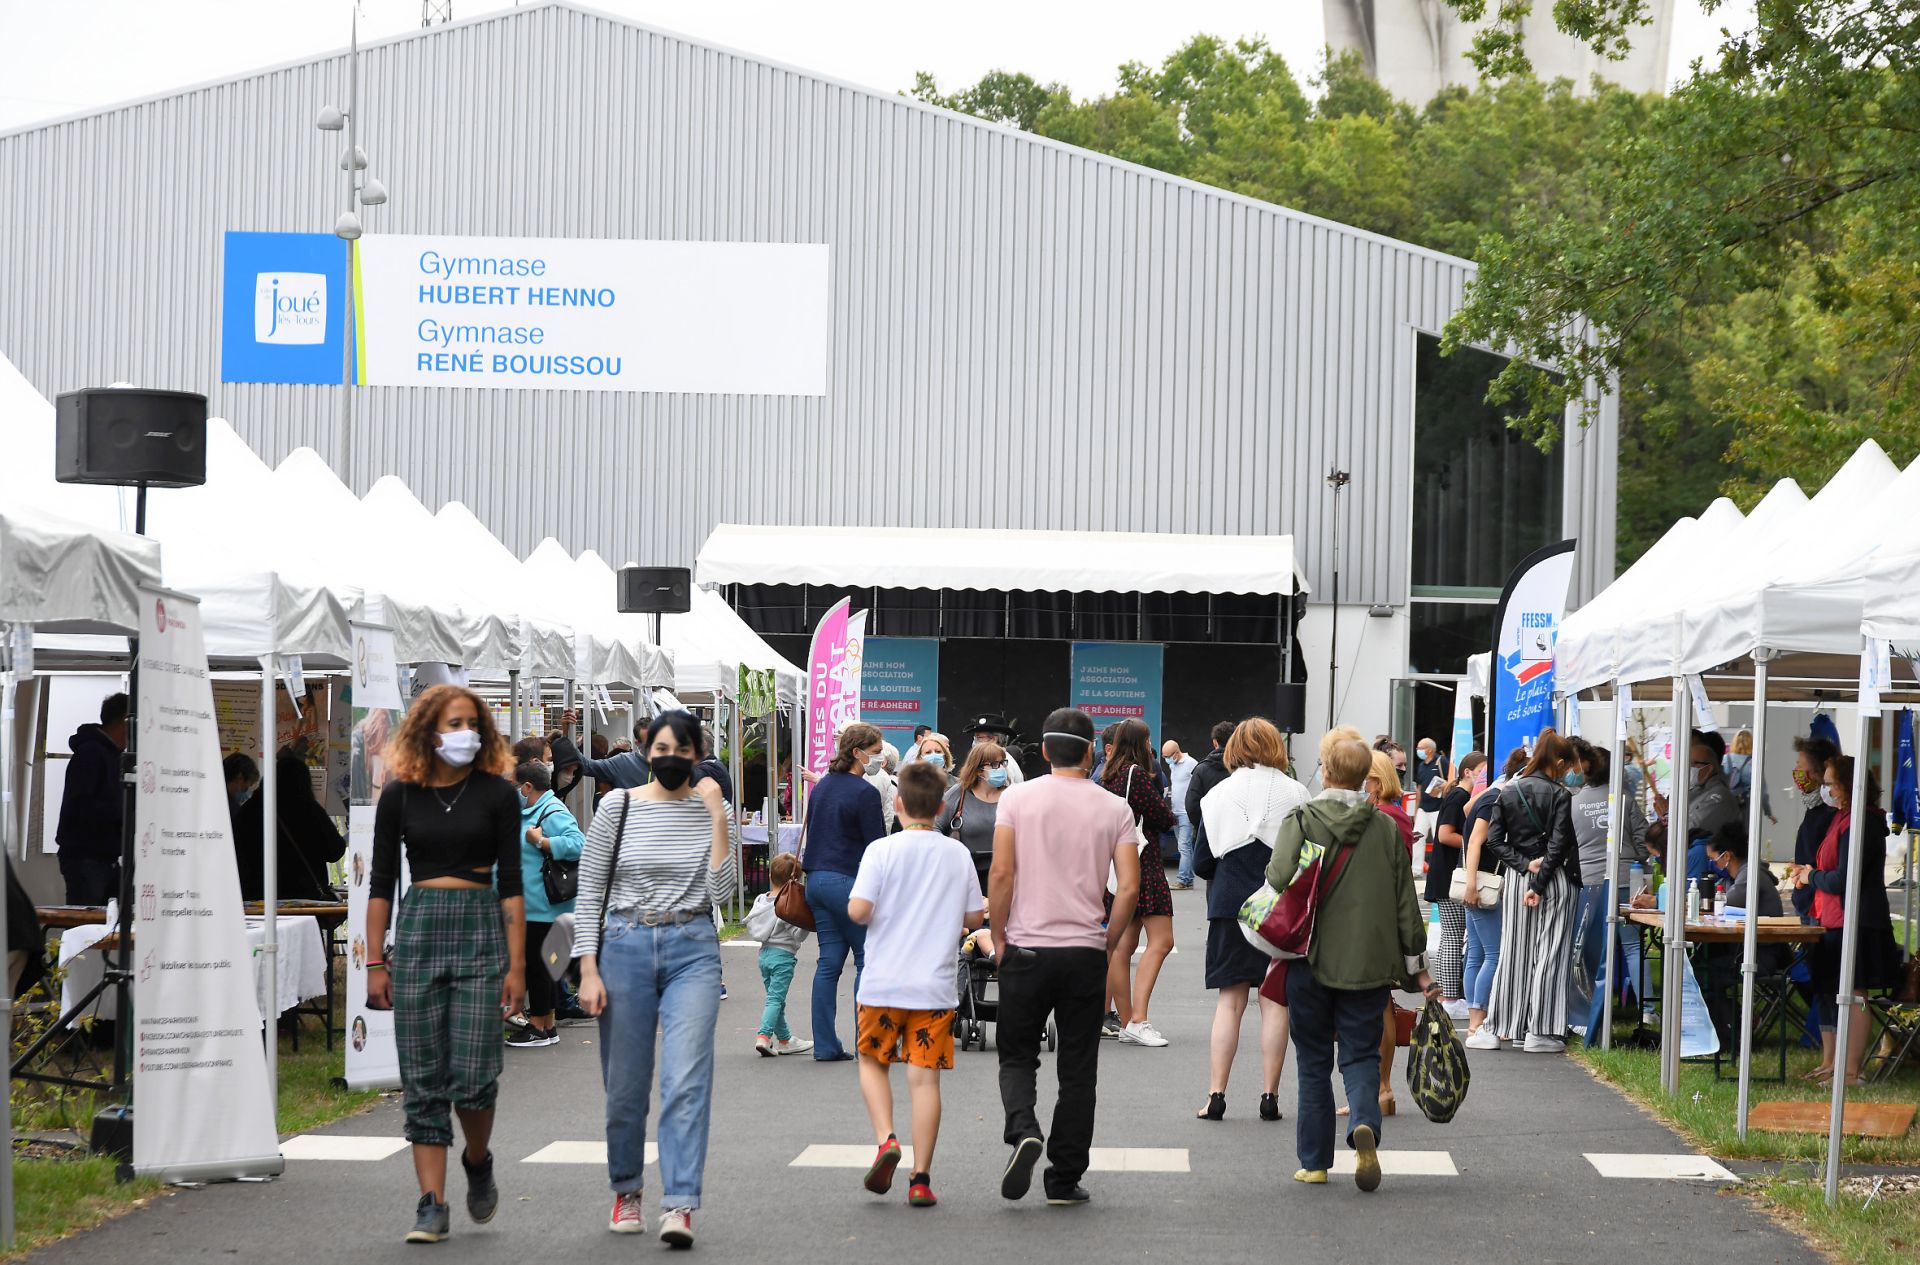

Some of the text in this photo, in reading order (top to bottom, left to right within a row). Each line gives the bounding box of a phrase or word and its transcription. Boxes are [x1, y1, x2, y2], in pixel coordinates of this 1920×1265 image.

[419, 251, 546, 280] Gymnase
[418, 284, 616, 308] HUBERT HENNO
[268, 279, 320, 337] joué
[417, 318, 545, 349] Gymnase
[417, 349, 622, 376] RENÉ BOUISSOU
[1521, 612, 1553, 628] FFESSM
[815, 662, 828, 699] DU
[861, 670, 914, 679] SSOCIATION
[1080, 676, 1138, 684] ASSOCIATION
[868, 684, 879, 692] LA
[880, 685, 922, 693] SOUTIENS
[1515, 687, 1528, 702] Le
[1080, 706, 1089, 714] JE
[1506, 702, 1544, 721] est sous
[1579, 800, 1607, 810] Plonger
